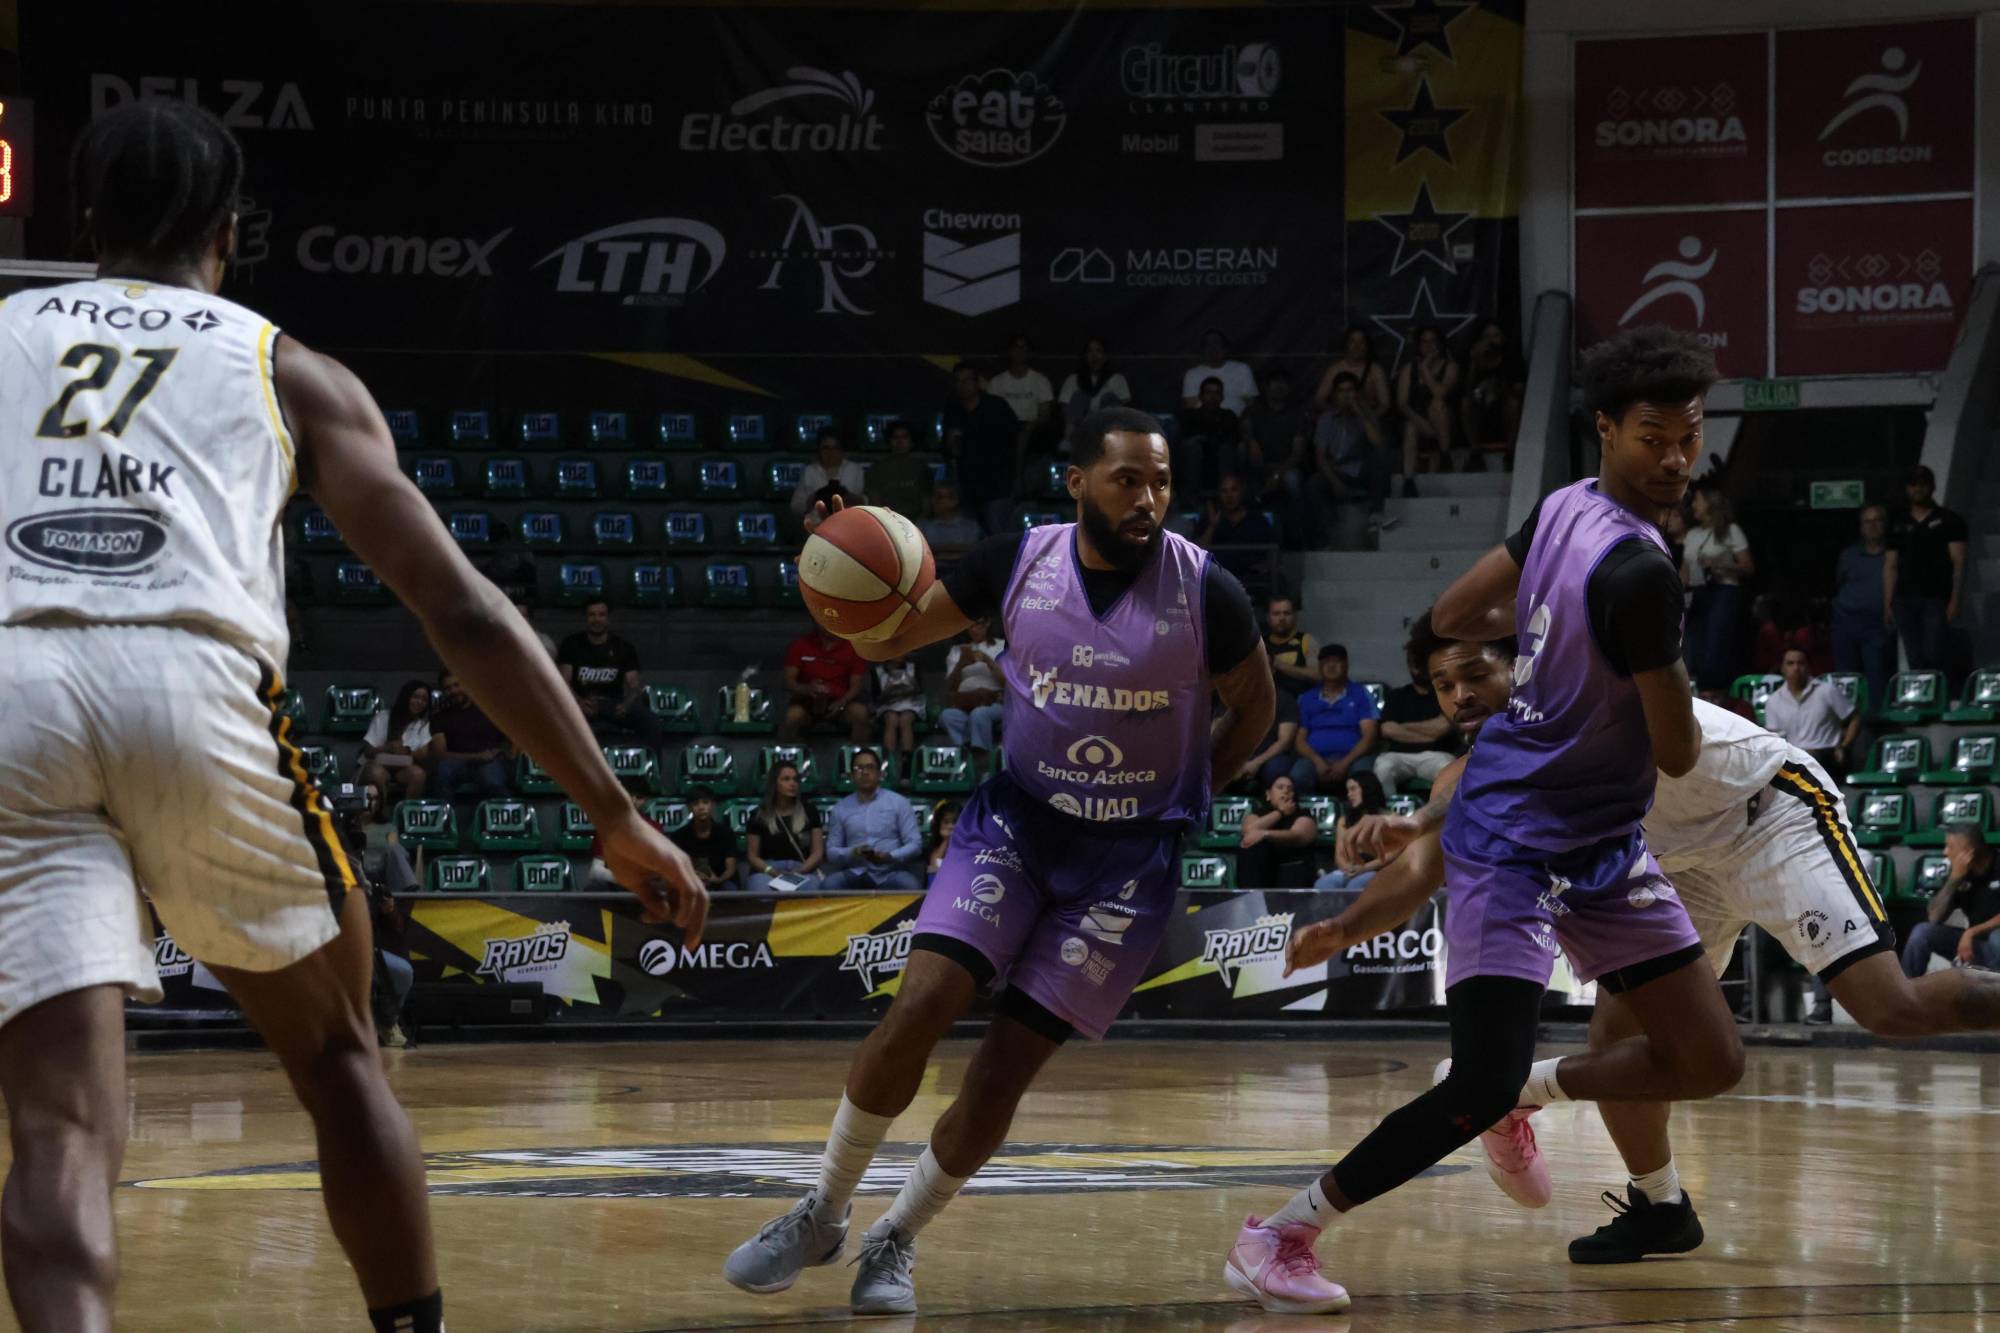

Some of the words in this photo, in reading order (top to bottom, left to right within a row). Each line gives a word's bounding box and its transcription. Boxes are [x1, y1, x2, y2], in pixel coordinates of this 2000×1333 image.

[346, 97, 426, 120] PUNTA
[442, 99, 580, 124] PENINSULA
[595, 102, 653, 126] KINO
[952, 90, 1035, 129] eat
[678, 110, 886, 152] Electrolit
[955, 129, 1032, 153] salad
[1121, 132, 1180, 152] Mobil
[1595, 115, 1747, 148] SONORA
[1823, 146, 1933, 167] CODESON
[922, 208, 1022, 230] Chevron
[296, 225, 516, 277] Comex
[1127, 247, 1278, 271] MADERAN
[556, 241, 697, 294] LTH
[1126, 272, 1192, 287] COCINAS
[1204, 270, 1268, 285] CLOSETS
[1796, 282, 1953, 314] SONORA
[36, 297, 172, 331] ARCO
[36, 342, 180, 439] 27
[38, 453, 177, 499] CLARK
[531, 517, 552, 532] 011
[601, 517, 625, 533] 012
[673, 516, 696, 532] 013
[744, 517, 768, 532] 014
[42, 527, 144, 552] TOMASON
[1021, 596, 1061, 611] telcel
[577, 666, 619, 684] RAYOS
[1028, 663, 1170, 712] VENADOS
[696, 752, 718, 769] 011
[929, 752, 954, 769] 014
[1092, 769, 1158, 785] Azteca
[408, 810, 437, 827] 007
[490, 809, 521, 826] 008
[656, 809, 683, 826] 010
[444, 866, 474, 884] 007
[528, 866, 560, 884] 008
[951, 896, 1000, 927] MEGA
[482, 931, 569, 981] RAYOS
[678, 942, 773, 969] MEGA
[843, 930, 912, 982] RAYO
[1203, 924, 1288, 974] RAYOS
[1346, 928, 1444, 960] ARCO
[1353, 964, 1395, 974] Gasolina
